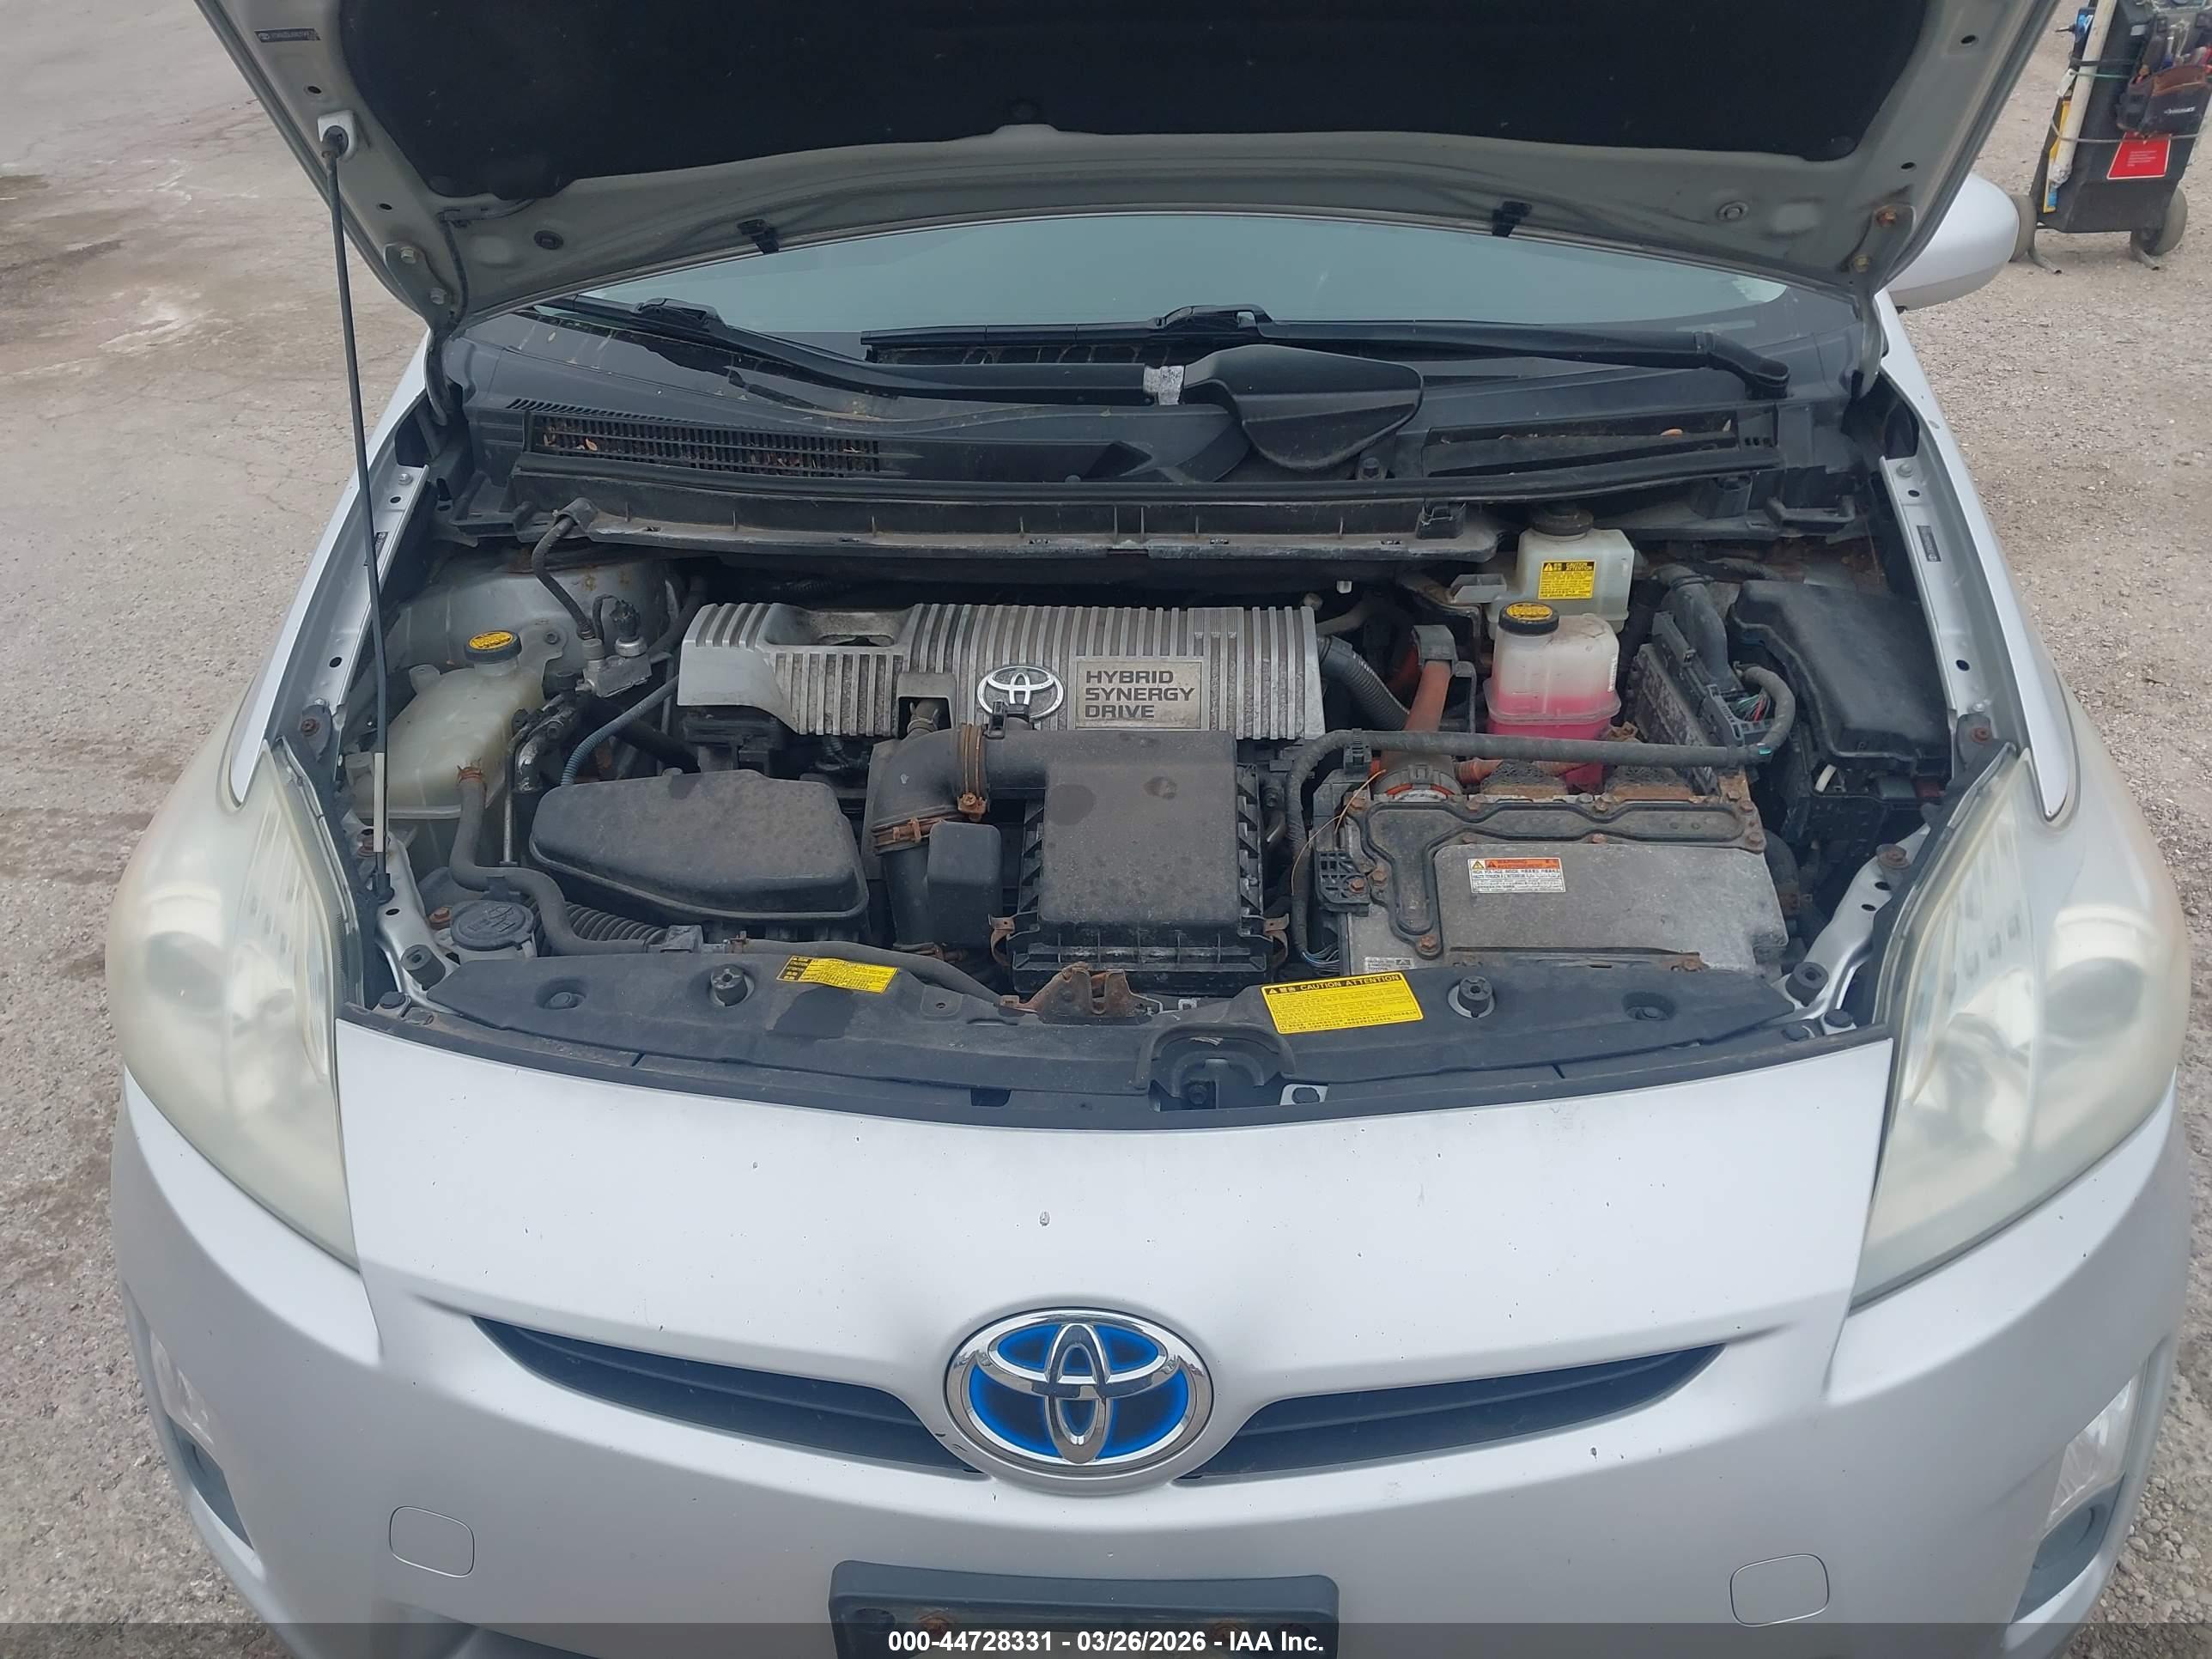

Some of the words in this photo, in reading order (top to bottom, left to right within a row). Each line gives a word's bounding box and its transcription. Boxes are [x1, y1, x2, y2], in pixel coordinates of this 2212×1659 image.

[1086, 671, 1174, 684] HYBRID
[1085, 688, 1195, 701] SYNERGY
[1085, 705, 1154, 718] DRIVE
[1300, 981, 1342, 992] CAUTION
[1346, 975, 1400, 987] ATTENTION
